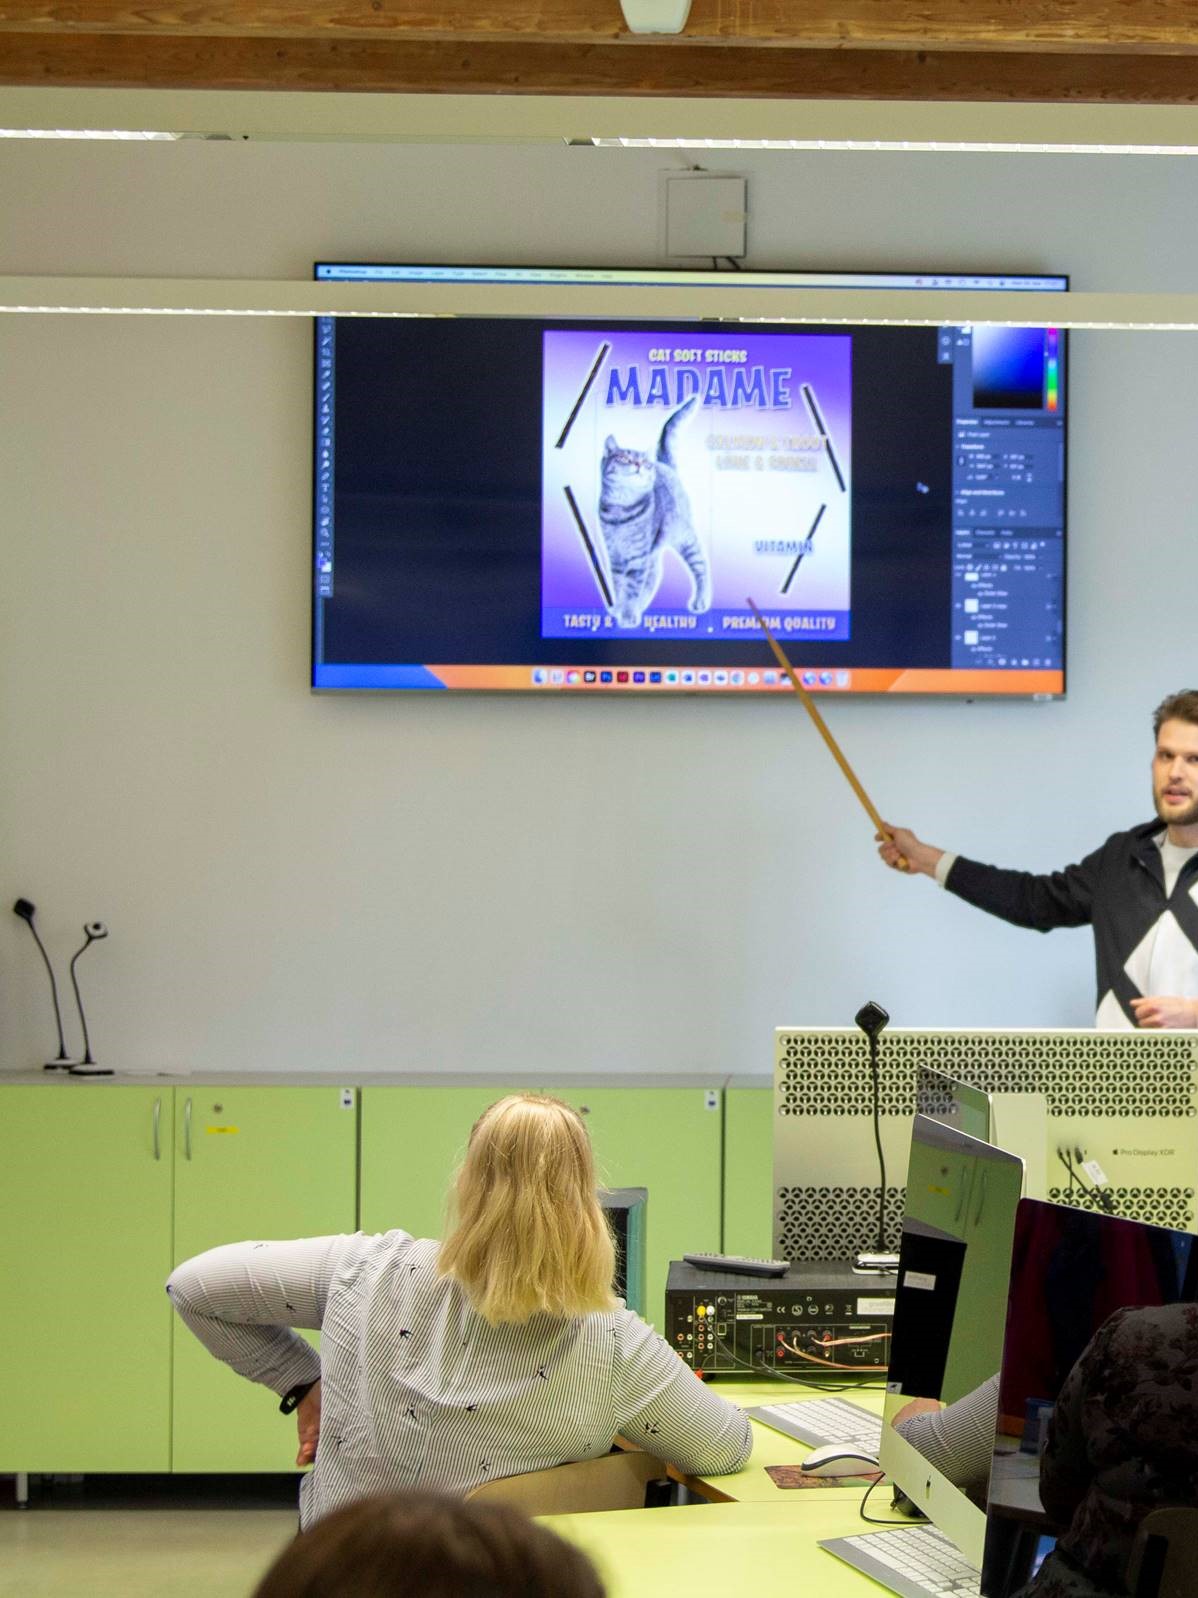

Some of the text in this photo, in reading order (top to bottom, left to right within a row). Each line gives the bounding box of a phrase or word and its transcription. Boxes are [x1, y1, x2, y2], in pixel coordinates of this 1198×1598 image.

[649, 349, 748, 363] CAT SOFT STICKS
[605, 366, 792, 409] MADAME
[784, 616, 836, 631] QUALITY
